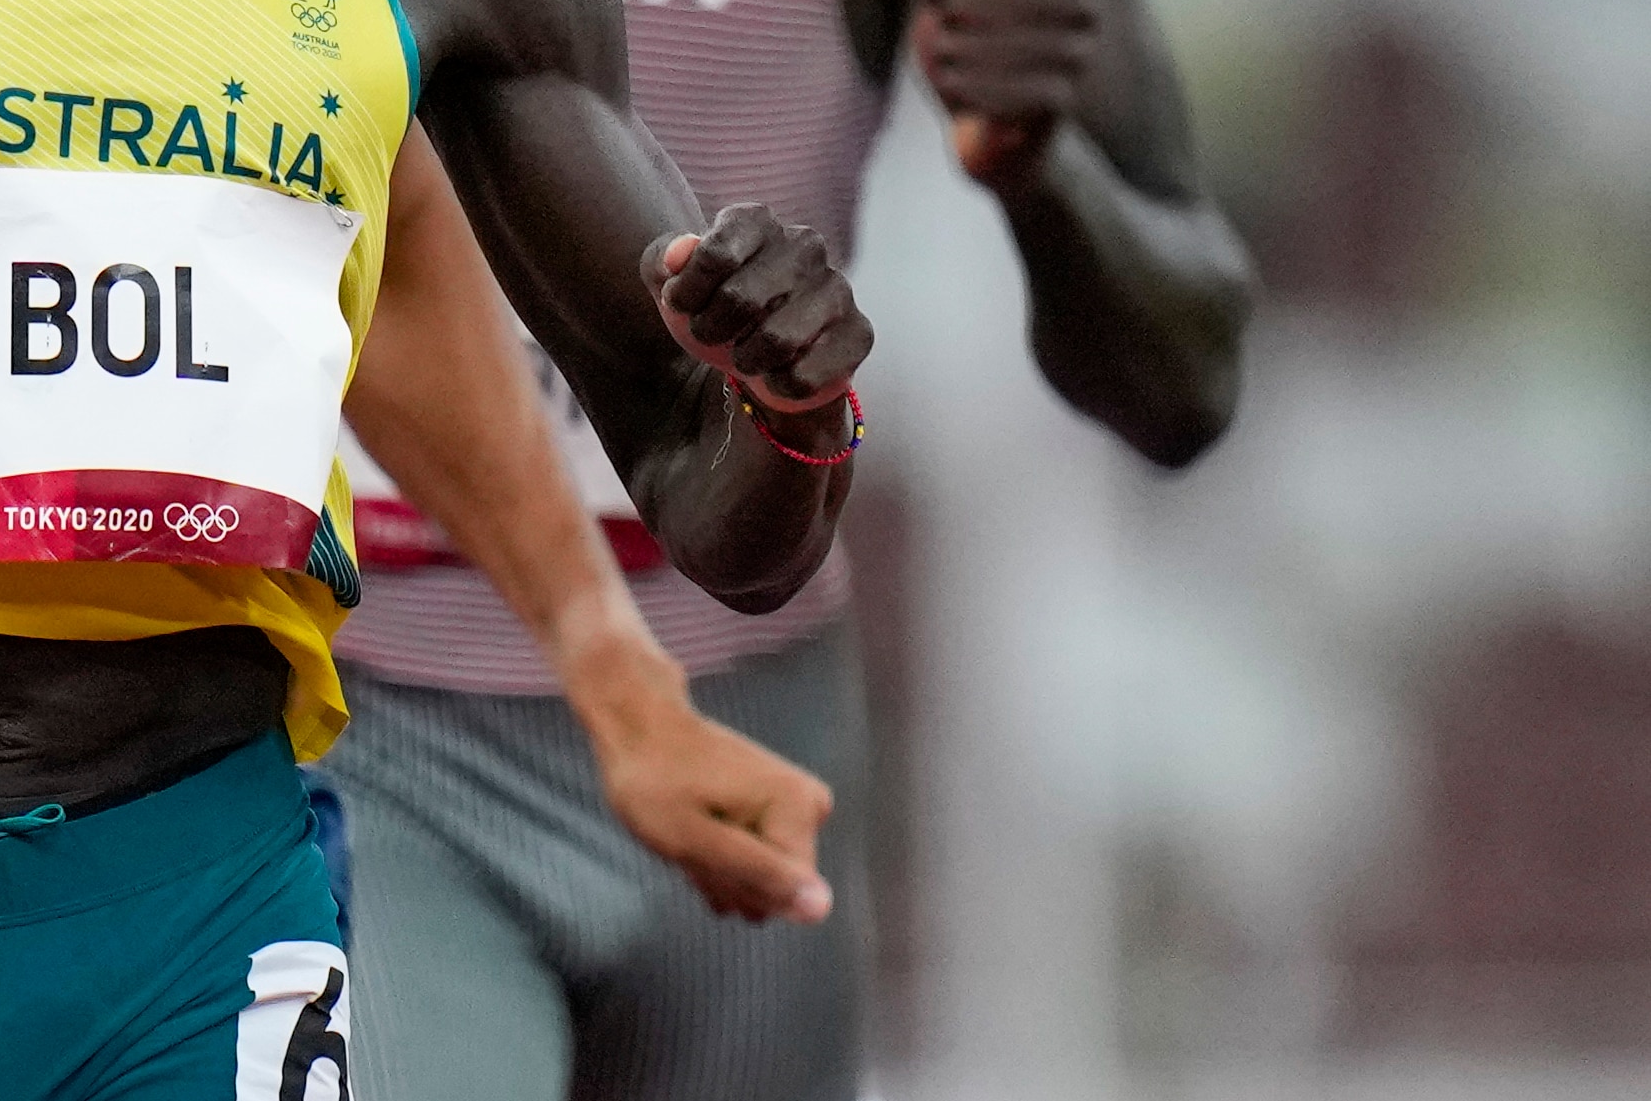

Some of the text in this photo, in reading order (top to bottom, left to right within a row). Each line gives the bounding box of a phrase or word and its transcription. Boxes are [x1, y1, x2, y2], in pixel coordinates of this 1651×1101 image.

[292, 31, 340, 50] AUSTRALIA
[292, 40, 342, 61] TOKYO 2020
[10, 261, 230, 383] BOL
[4, 506, 154, 533] TOKYO 2020
